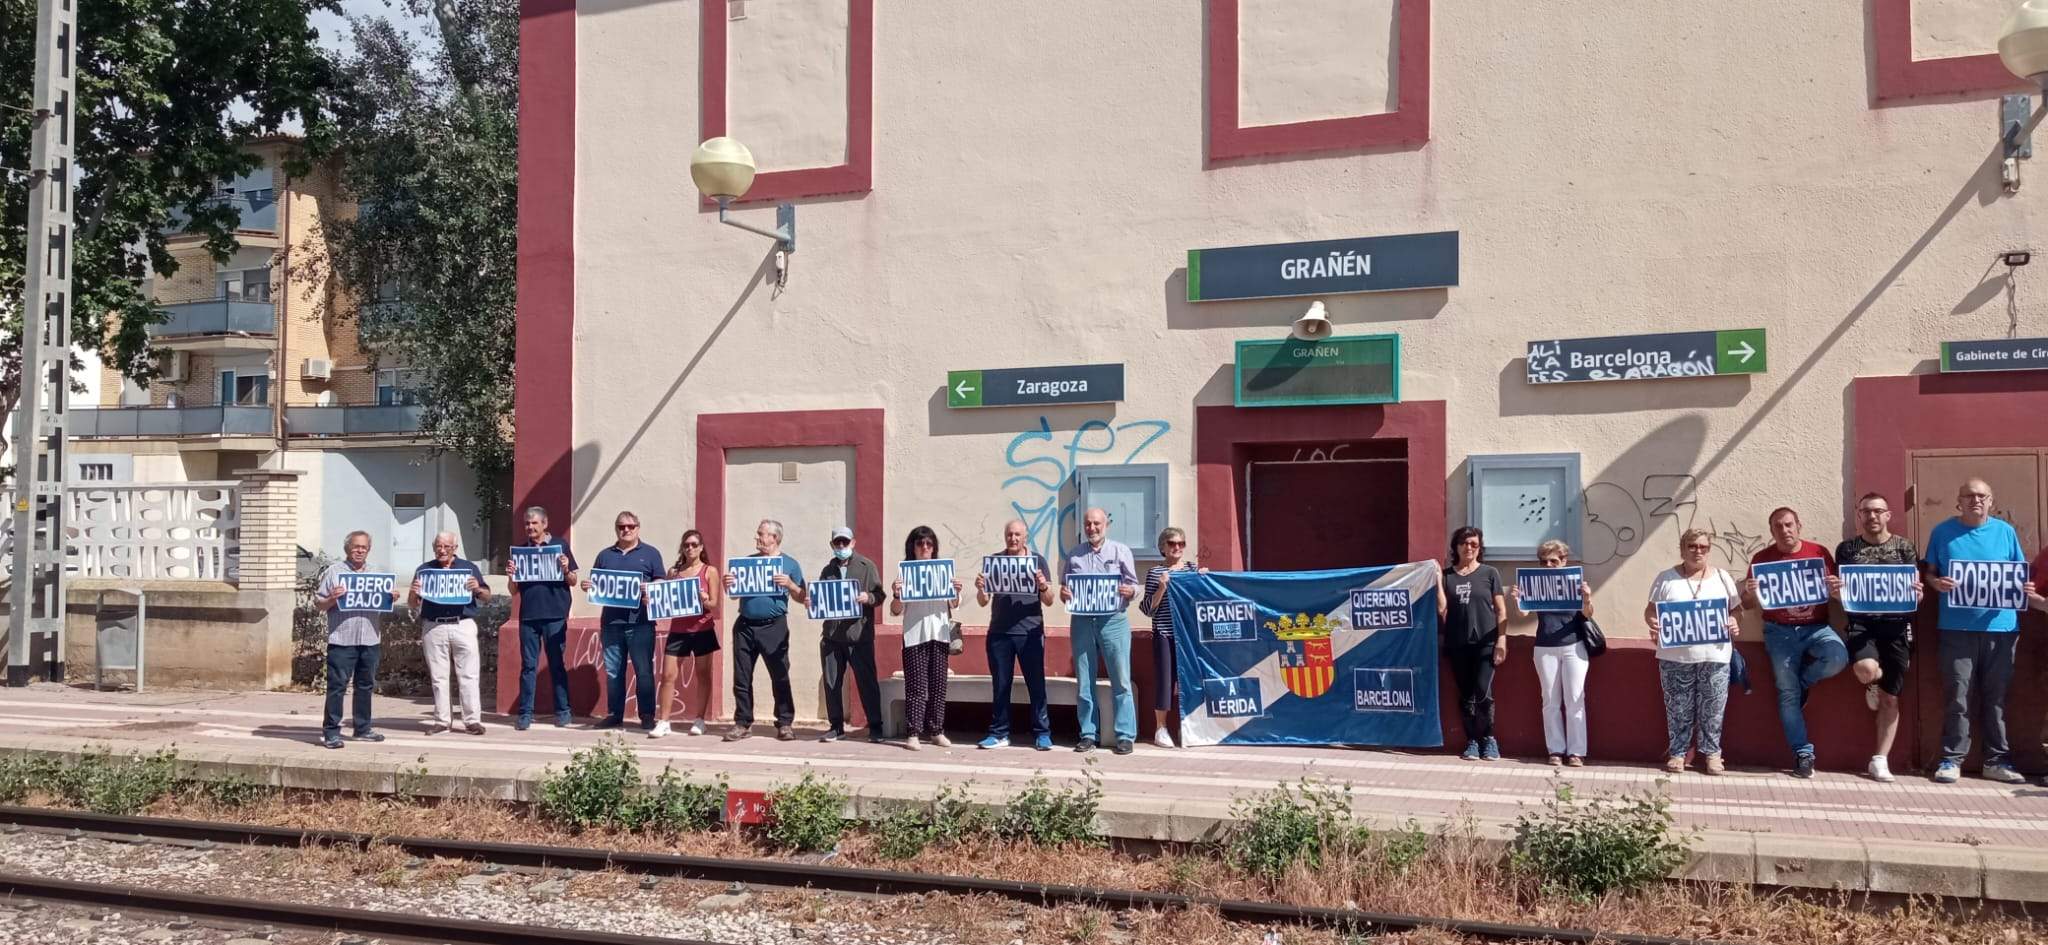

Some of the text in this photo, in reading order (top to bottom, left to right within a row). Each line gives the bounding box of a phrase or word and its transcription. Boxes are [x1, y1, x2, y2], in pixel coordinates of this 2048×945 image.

[1281, 251, 1371, 280] GRAÑÉN
[1570, 349, 1671, 369] Barcelona
[1956, 347, 2048, 361] Gabinete de Cir
[1017, 379, 1088, 397] Zaragoza
[339, 576, 394, 593] ALBERO
[589, 573, 641, 600] SODETO
[730, 559, 783, 593] GRAÑÉN
[899, 563, 955, 599] VALFONDA
[984, 556, 1037, 594] ROBRES
[1757, 561, 1829, 606] GRAÑÉN
[1951, 562, 2026, 608] ROBRES
[648, 578, 701, 619] FRAELLA
[808, 580, 861, 618] CALLEN
[1519, 574, 1581, 601] ALMUNIENTE
[345, 593, 382, 608] BAJO
[1353, 591, 1407, 608] QUEREMOS
[1355, 611, 1408, 626] TRENES
[1660, 601, 1729, 643] GRAÑÉN
[1229, 681, 1237, 696] A
[1379, 673, 1385, 687] Y
[1211, 697, 1257, 715] LÉRIDA
[1357, 689, 1411, 707] BARCELONA
